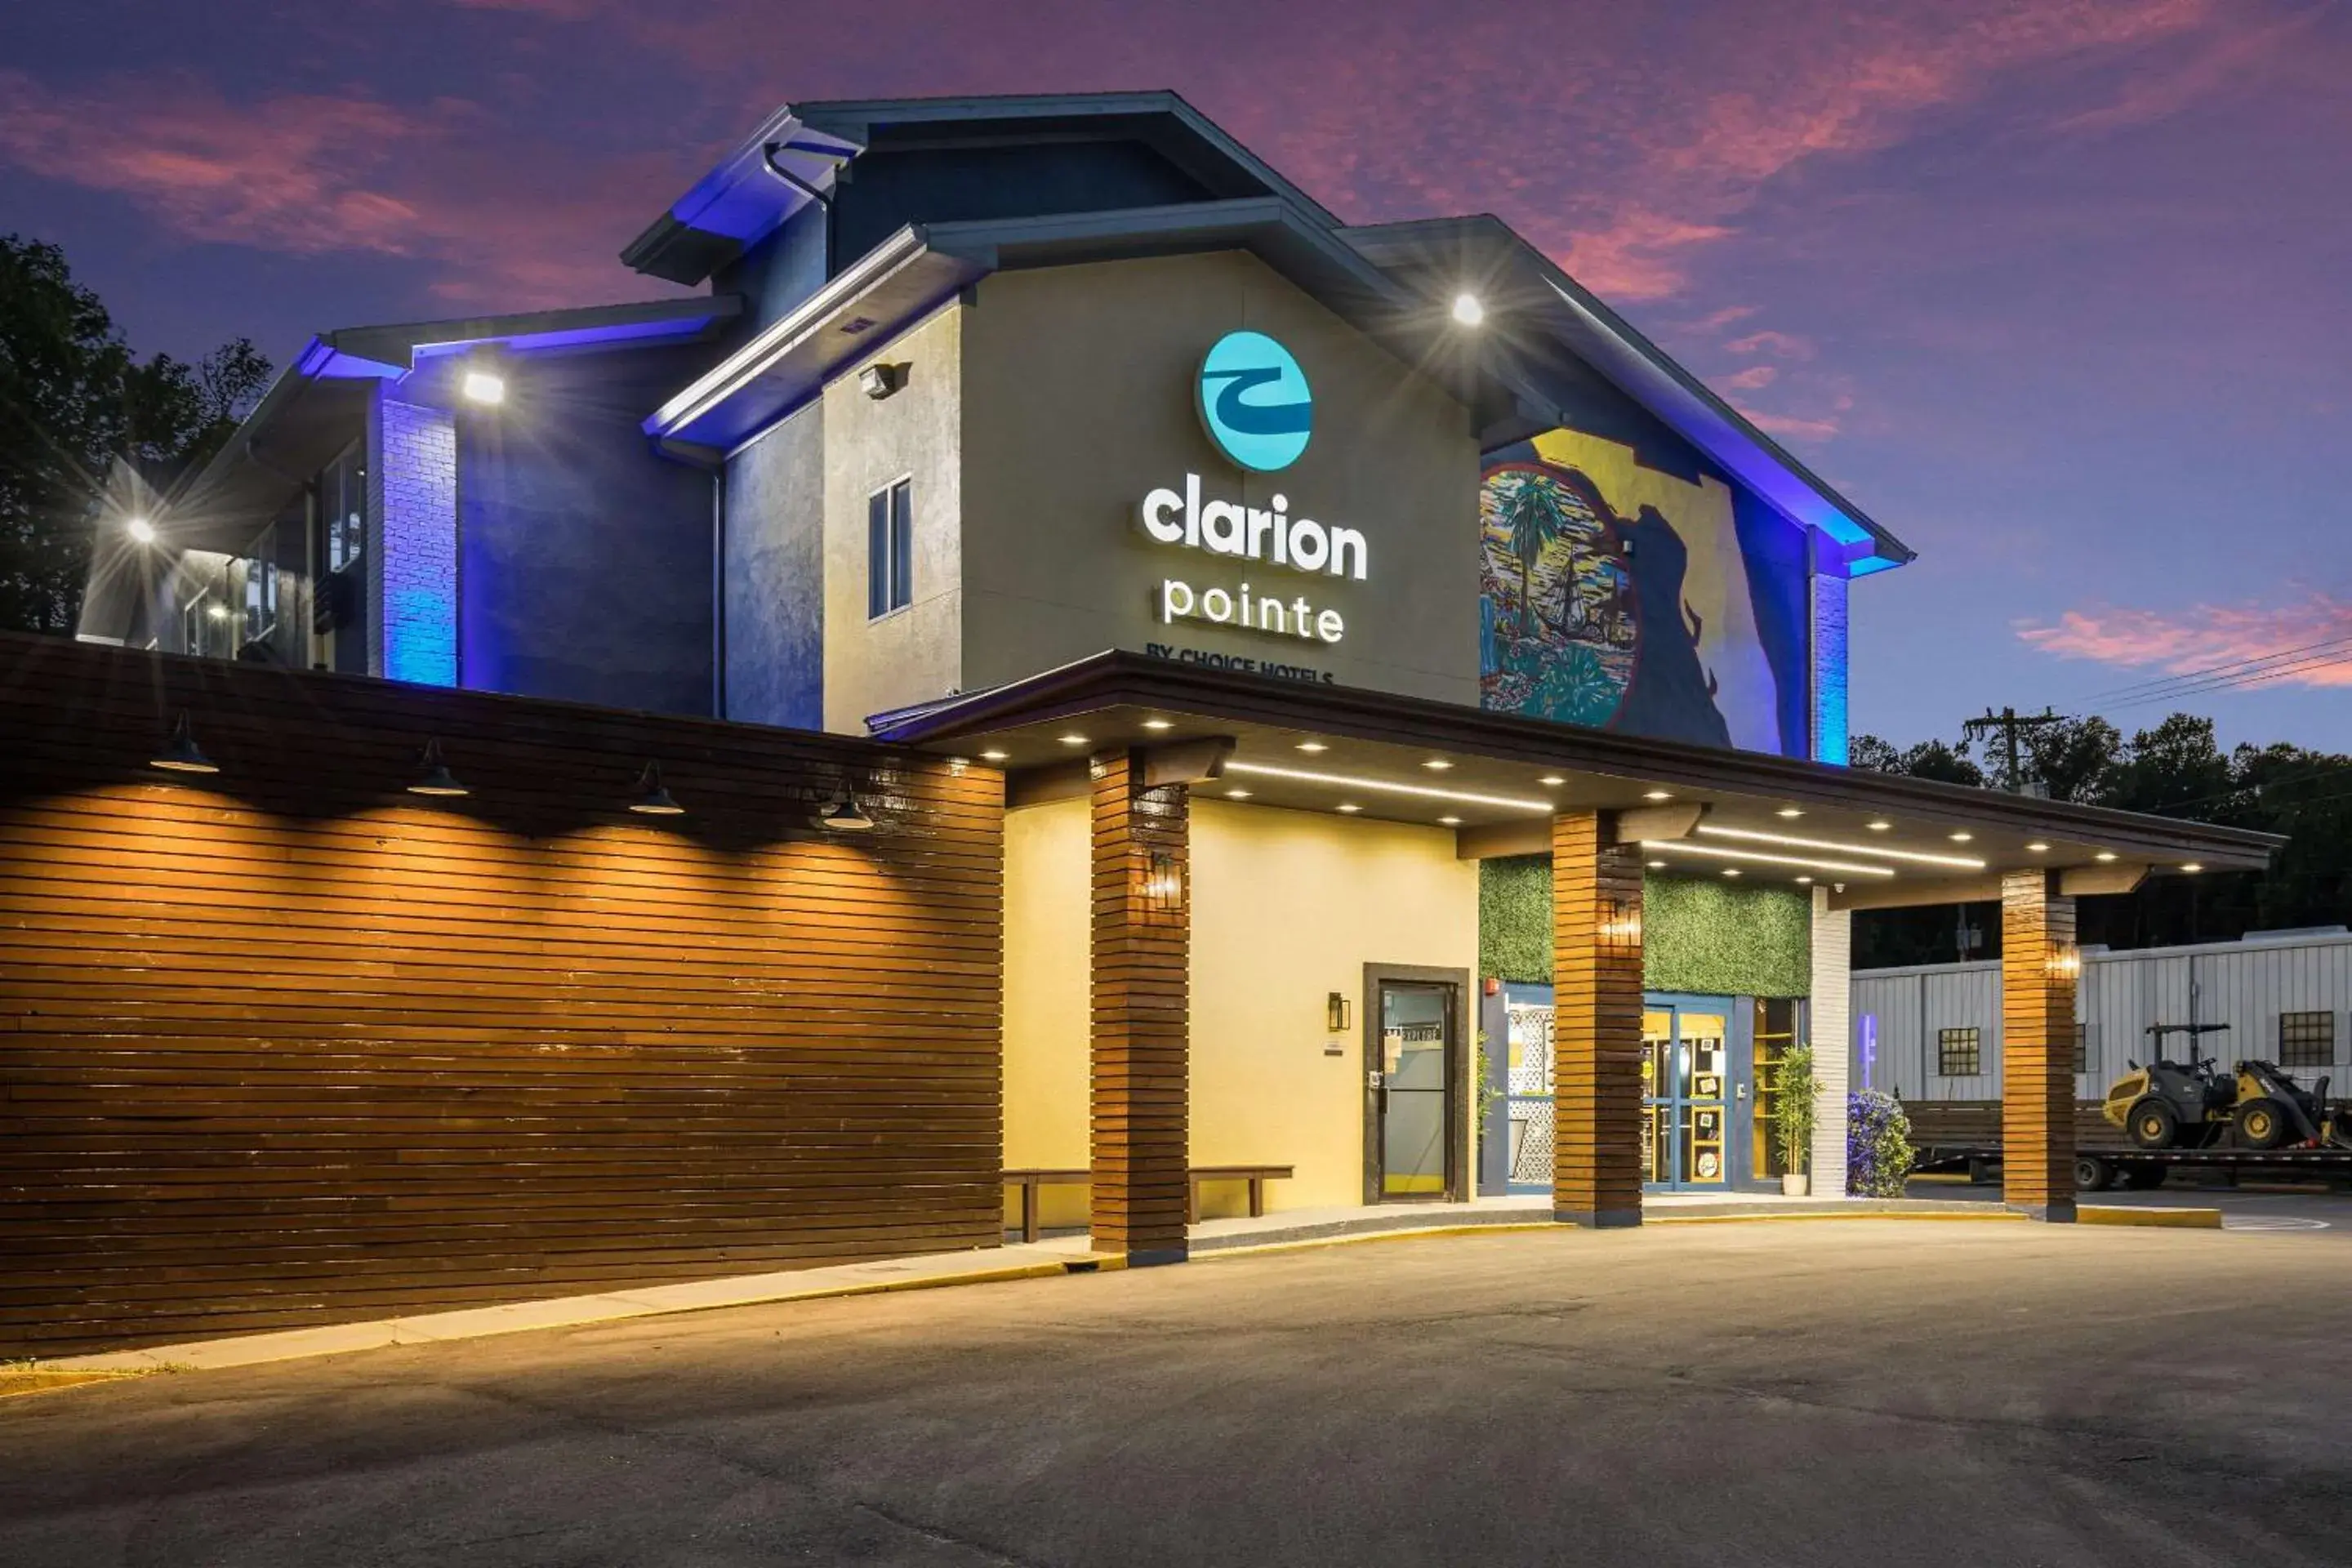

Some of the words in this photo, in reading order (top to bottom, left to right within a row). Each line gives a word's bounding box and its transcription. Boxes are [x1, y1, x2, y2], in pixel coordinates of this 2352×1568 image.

[1143, 473, 1367, 580] clarion
[1164, 579, 1343, 643] pointe
[1146, 643, 1174, 658] BY
[1180, 648, 1255, 670] CHOICE
[1261, 661, 1334, 685] HOTELS
